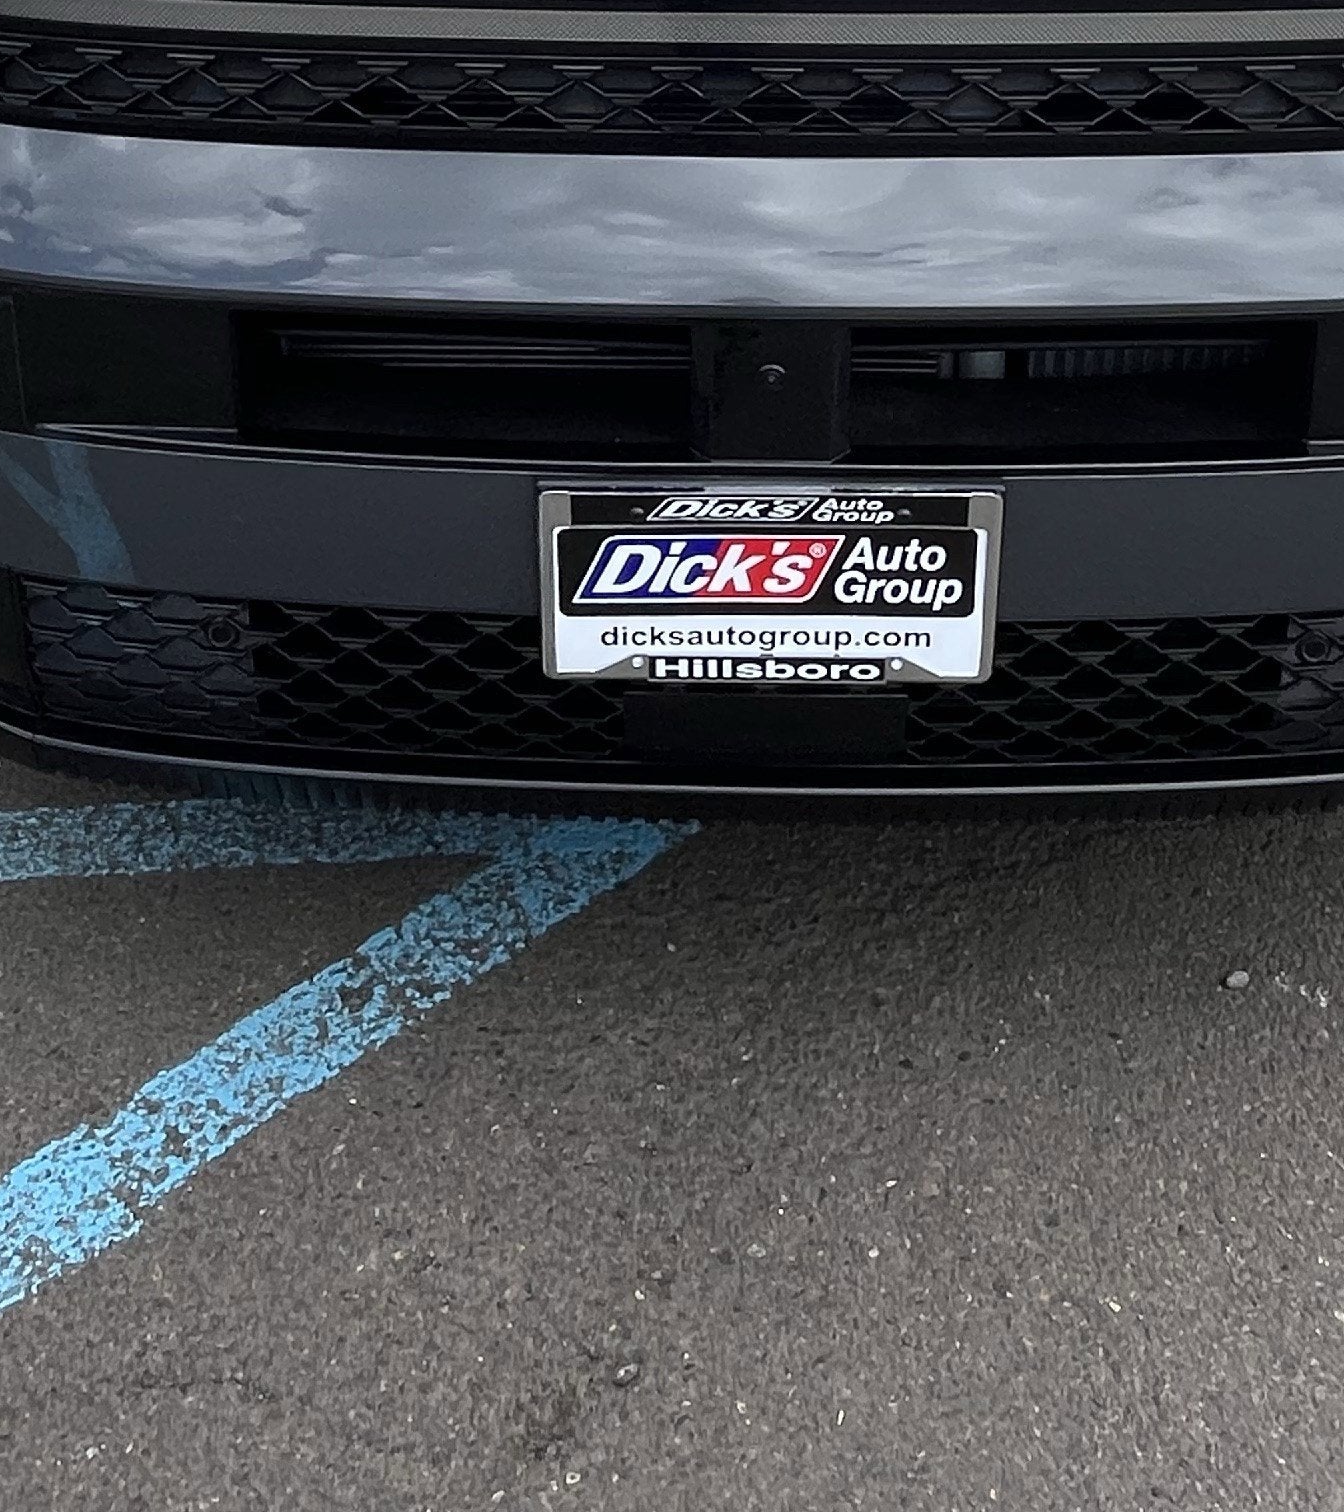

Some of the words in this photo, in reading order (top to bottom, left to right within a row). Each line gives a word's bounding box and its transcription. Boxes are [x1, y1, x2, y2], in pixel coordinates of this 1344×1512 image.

[821, 498, 884, 511] Auto
[812, 510, 895, 525] Group
[841, 536, 947, 572] Auto
[833, 571, 963, 611] Group
[600, 625, 932, 651] dicksautogroup.com
[655, 658, 882, 681] Hillsboro
